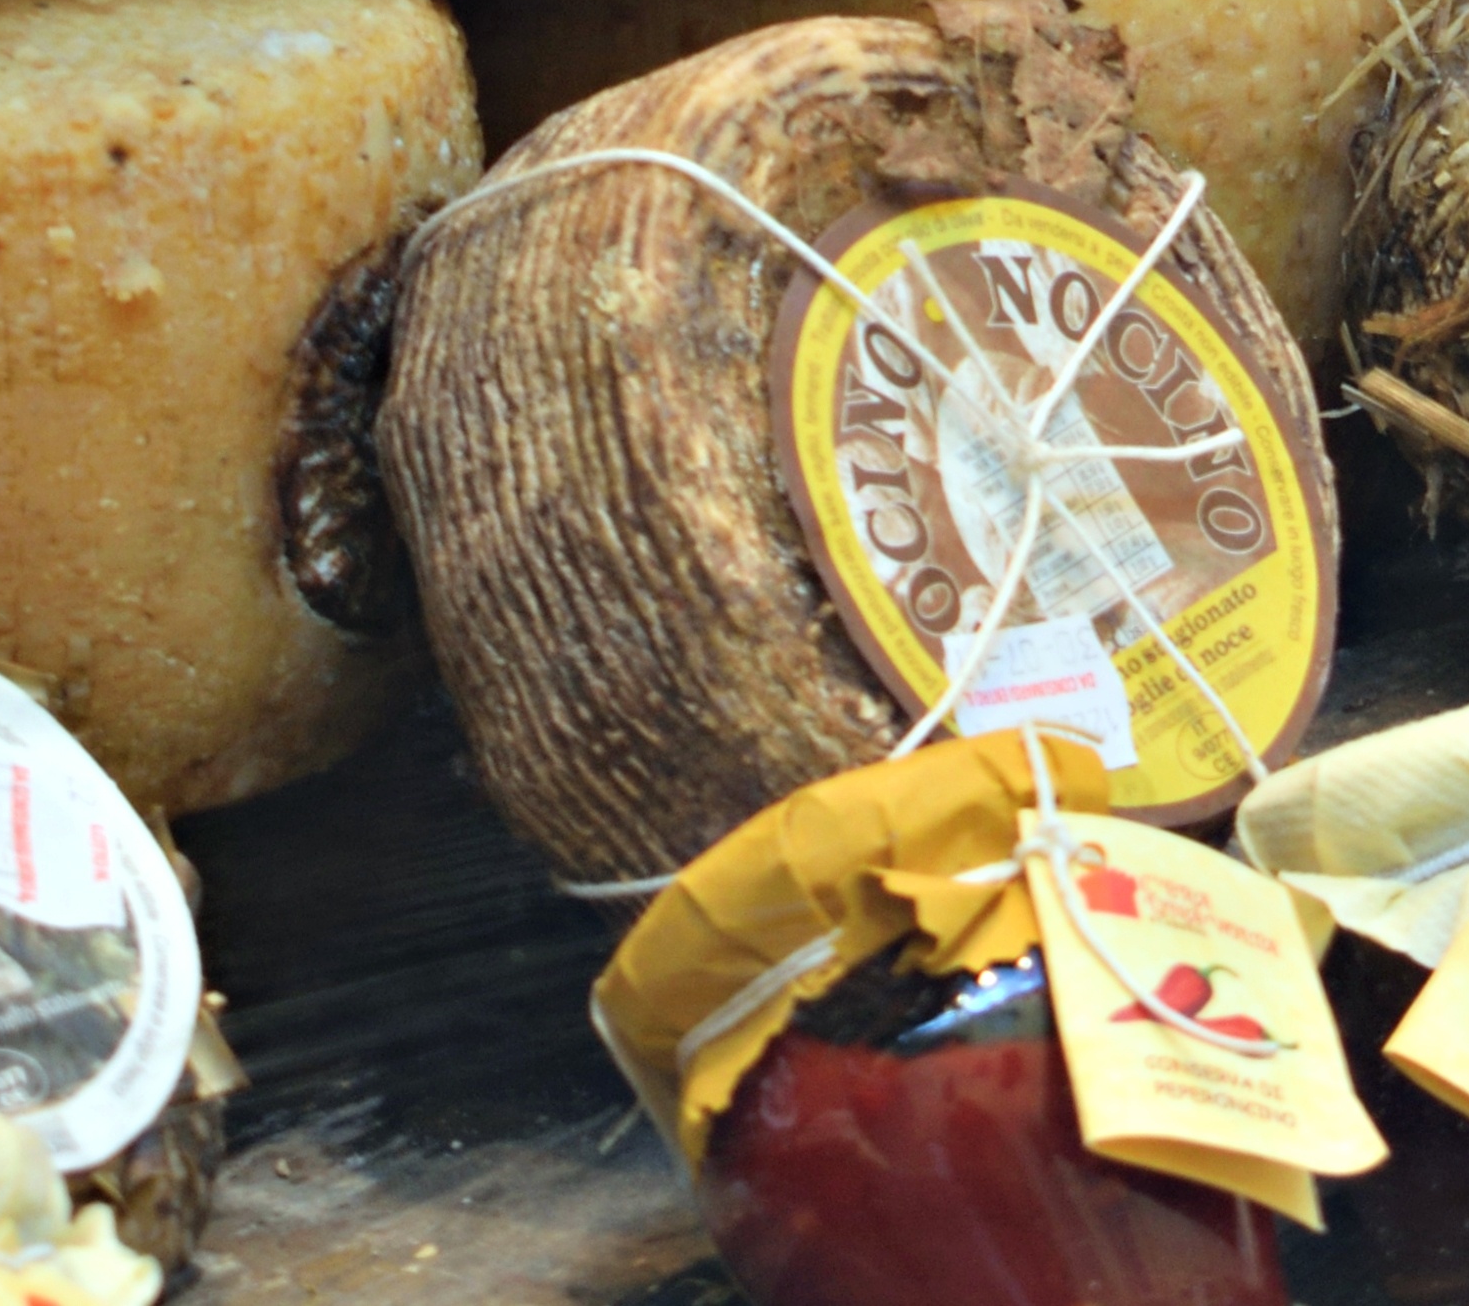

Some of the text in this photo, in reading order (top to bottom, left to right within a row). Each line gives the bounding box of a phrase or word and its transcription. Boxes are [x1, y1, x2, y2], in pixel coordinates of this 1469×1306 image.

[1000, 207, 1024, 229] Da
[1150, 282, 1196, 331] Crosta
[1194, 329, 1219, 359] non
[971, 251, 1264, 555] NOCINO
[1217, 359, 1255, 411] edibile
[1253, 423, 1297, 521] Conservare
[1286, 544, 1305, 591] luogo
[1286, 593, 1307, 643] fresco
[1198, 623, 1255, 667] noce
